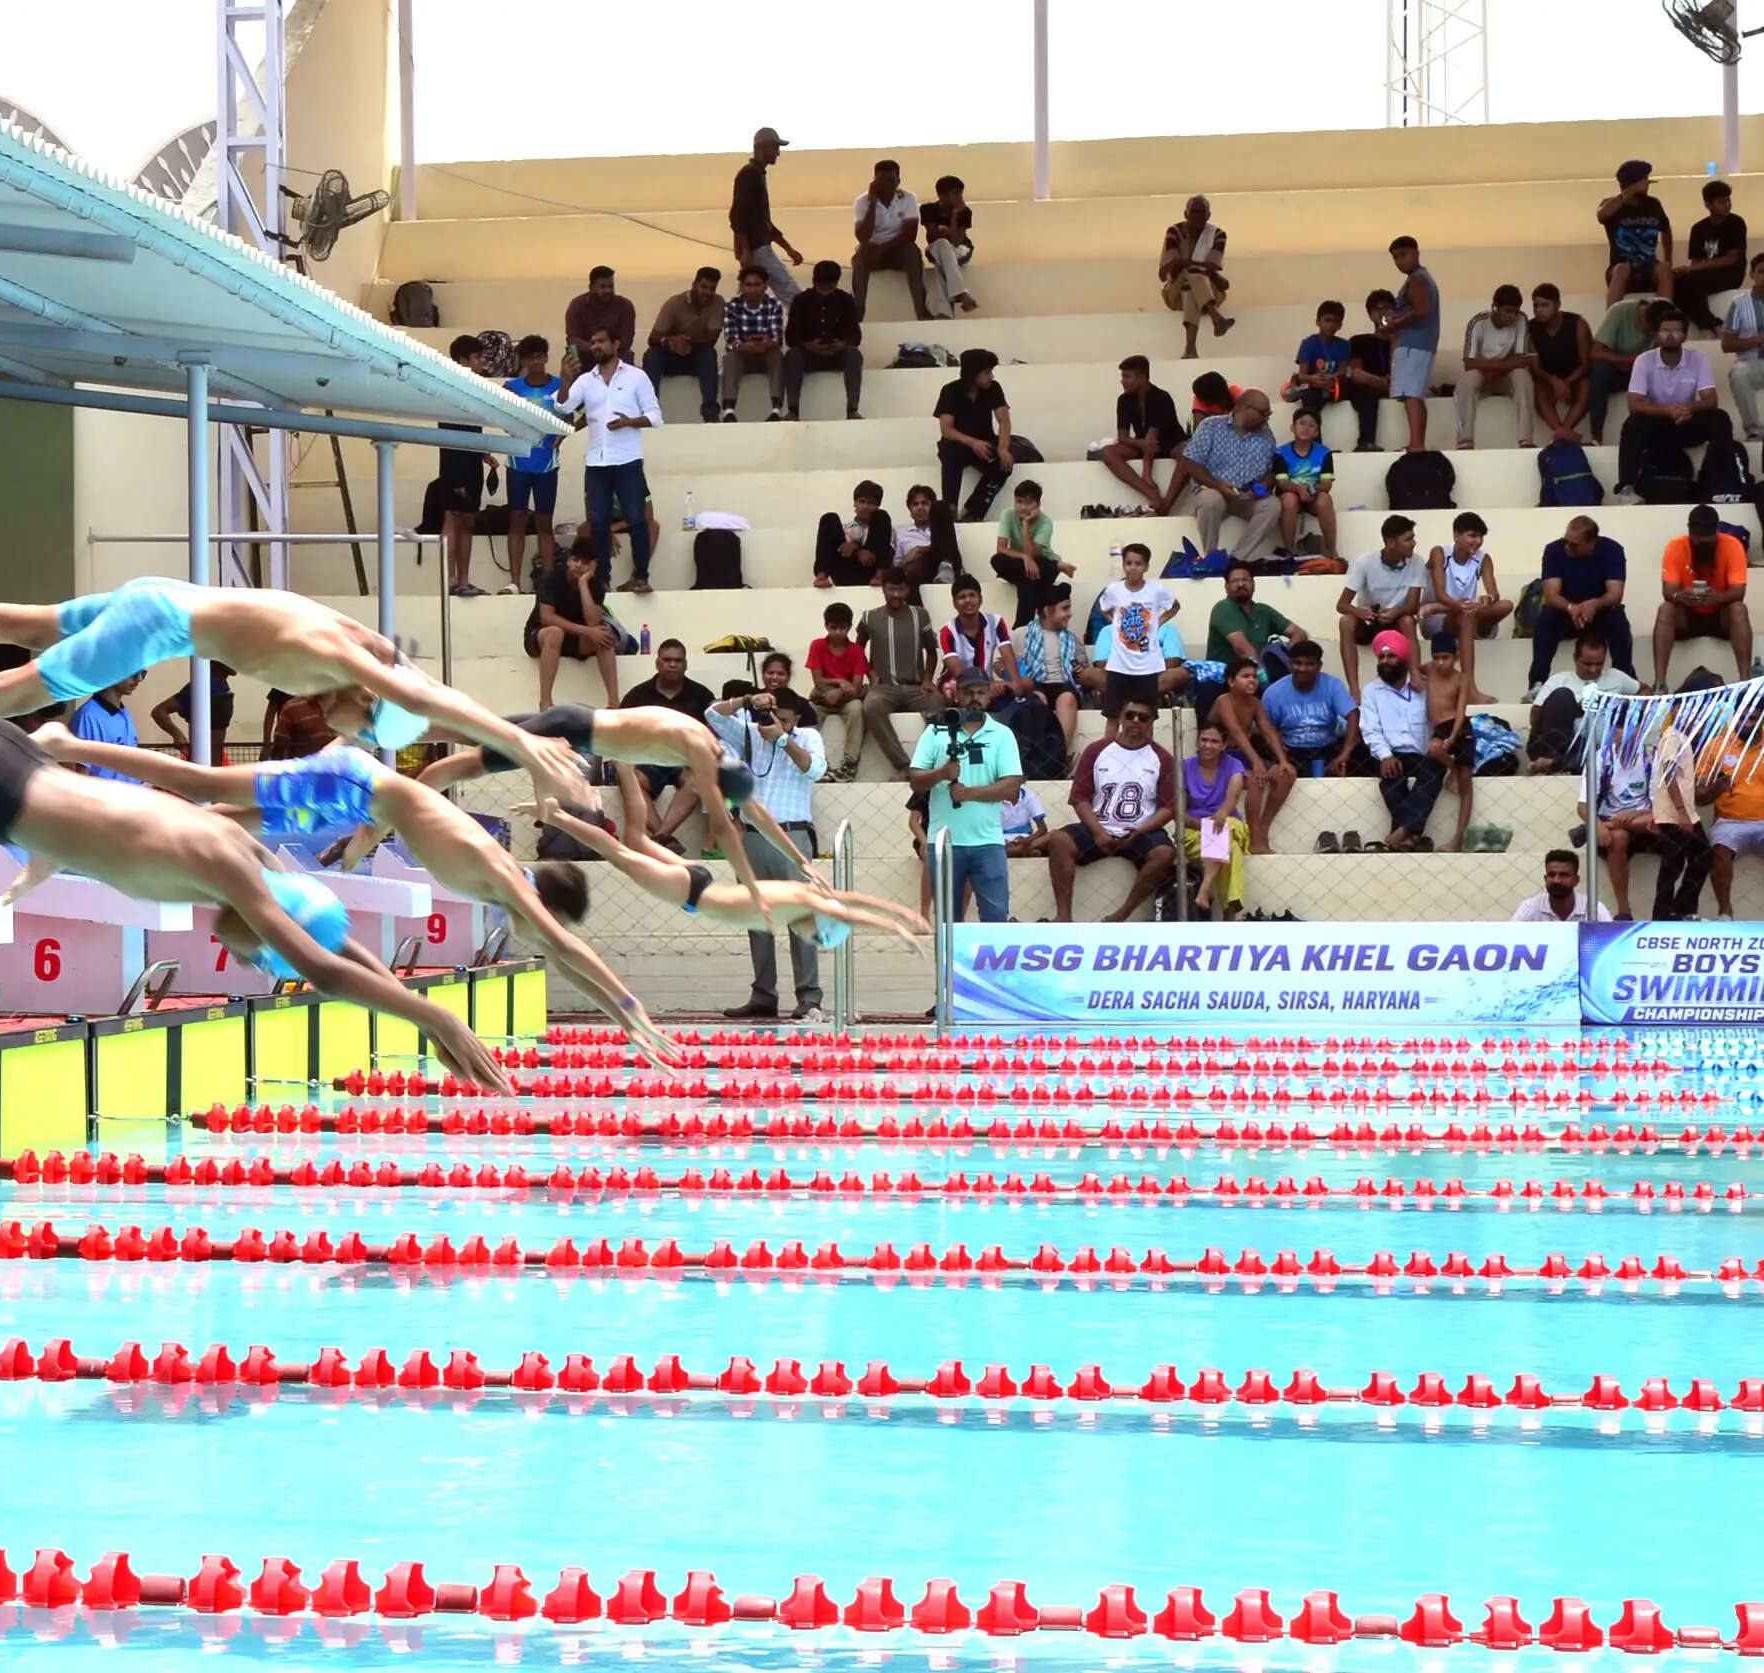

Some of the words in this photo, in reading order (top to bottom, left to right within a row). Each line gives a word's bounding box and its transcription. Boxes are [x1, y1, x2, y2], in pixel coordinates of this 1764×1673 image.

[1098, 781, 1144, 822] 18
[427, 913, 447, 944] 9
[211, 934, 229, 972] 7
[1636, 936, 1681, 950] CBSE
[1686, 936, 1743, 950] NORTH
[34, 937, 61, 982] 6
[972, 944, 1084, 972] MSG
[1092, 944, 1291, 972] BHARTIYA
[1300, 944, 1395, 972] KHEL
[1406, 943, 1549, 972] GAON
[1671, 953, 1761, 974] BOYS
[1087, 990, 1135, 1010] DERA
[1140, 990, 1201, 1010] SACHA
[1206, 990, 1271, 1013] SAUDA,
[1277, 990, 1335, 1013] SIRSA,
[1341, 990, 1421, 1010] HARYANA
[1612, 974, 1764, 1002] SWIMMI
[1633, 1007, 1764, 1021] CHAMPIONSHIP
